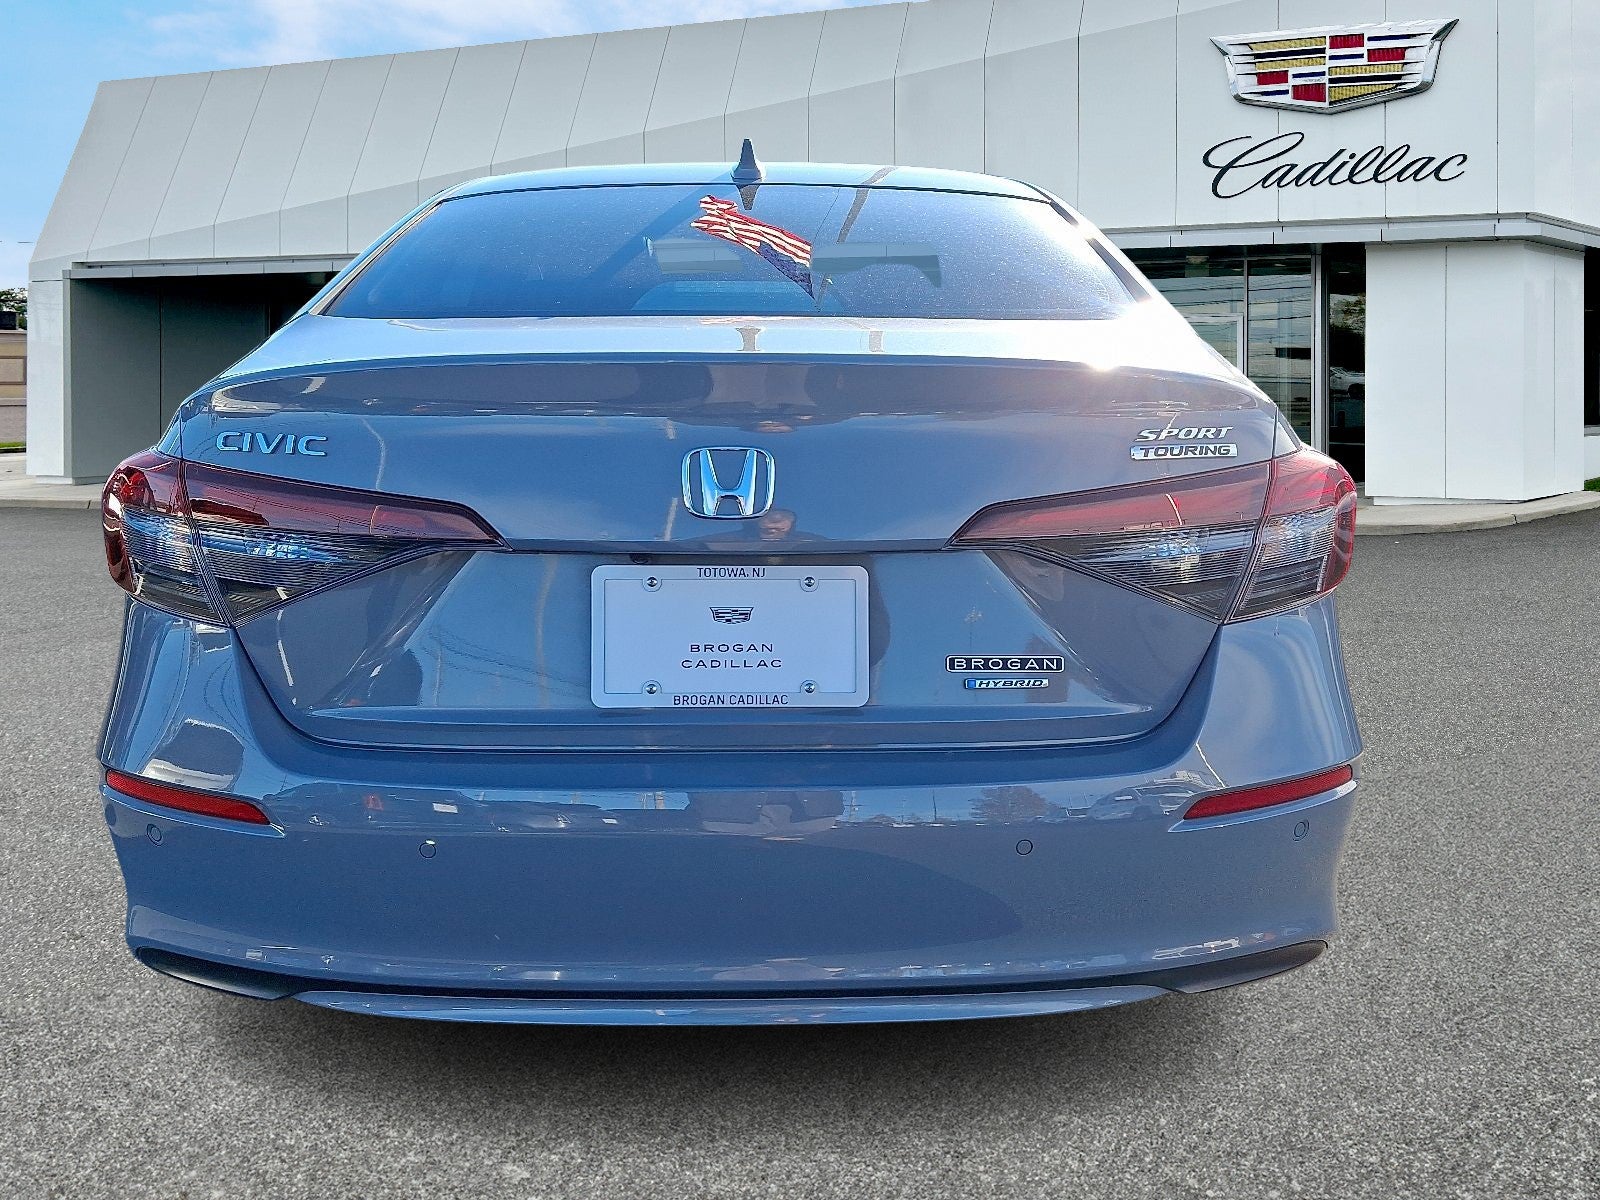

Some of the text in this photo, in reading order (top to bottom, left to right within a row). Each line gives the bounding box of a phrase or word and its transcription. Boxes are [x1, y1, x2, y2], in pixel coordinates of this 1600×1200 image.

[1202, 131, 1468, 199] Cadillac
[1134, 426, 1234, 442] SPORT
[216, 431, 328, 456] CIVIC
[1139, 445, 1231, 458] TOURING
[752, 567, 766, 578] NJ
[690, 643, 774, 653] BROGAN
[681, 659, 782, 669] CADILLAC
[954, 658, 1057, 670] BROGAN
[978, 679, 1043, 688] HYBRID
[673, 694, 789, 706] BROGAN CADILLAC
